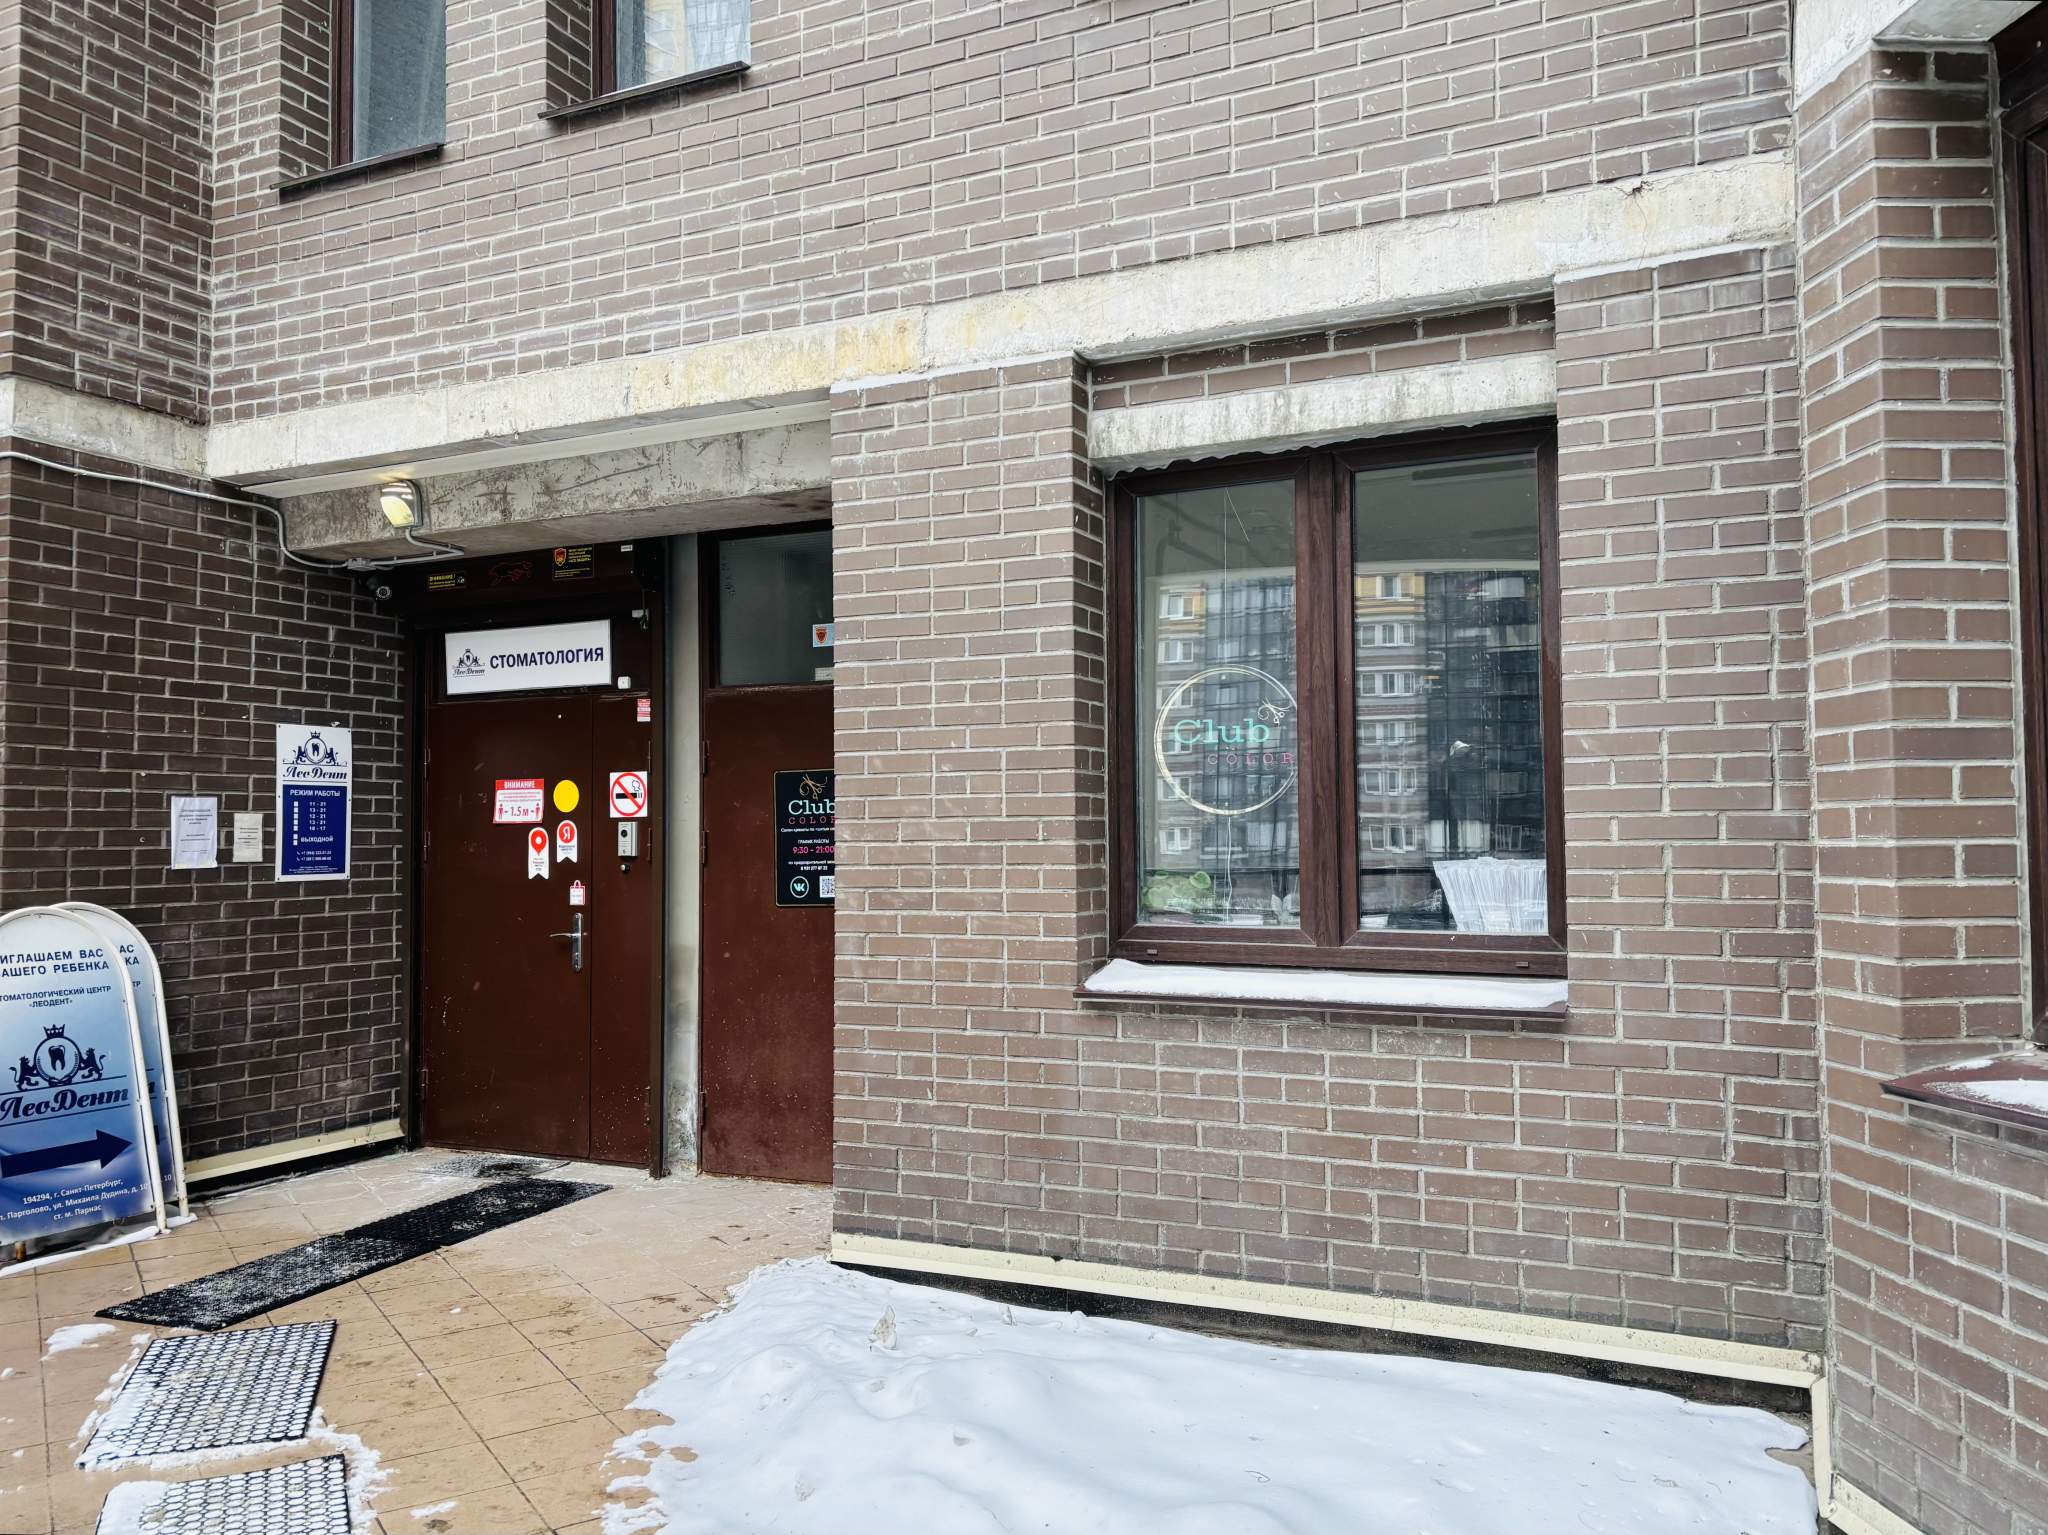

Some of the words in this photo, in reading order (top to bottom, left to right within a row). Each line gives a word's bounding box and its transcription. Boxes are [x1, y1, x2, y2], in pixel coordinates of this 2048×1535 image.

[490, 647, 604, 669] СТОМАТОЛОГИЯ
[1174, 718, 1270, 744] Club
[1207, 752, 1295, 765] COLOR
[503, 780, 535, 789] ВНИМАНИЕ
[788, 799, 835, 815] Club
[563, 826, 571, 840] Я
[792, 846, 809, 854] 9:30
[79, 948, 104, 959] ВАС
[53, 960, 110, 973] РЕБЕНКА
[86, 985, 111, 994] ЦЕНТР
[23, 1192, 52, 1205] 194294,
[60, 1178, 124, 1197] Санкт-Петербург,
[7, 1205, 52, 1220] Парголово,
[52, 1202, 64, 1211] ул.
[65, 1193, 100, 1207] Михаила
[100, 1188, 130, 1201] Дудина,
[74, 1204, 102, 1216] Парнас
